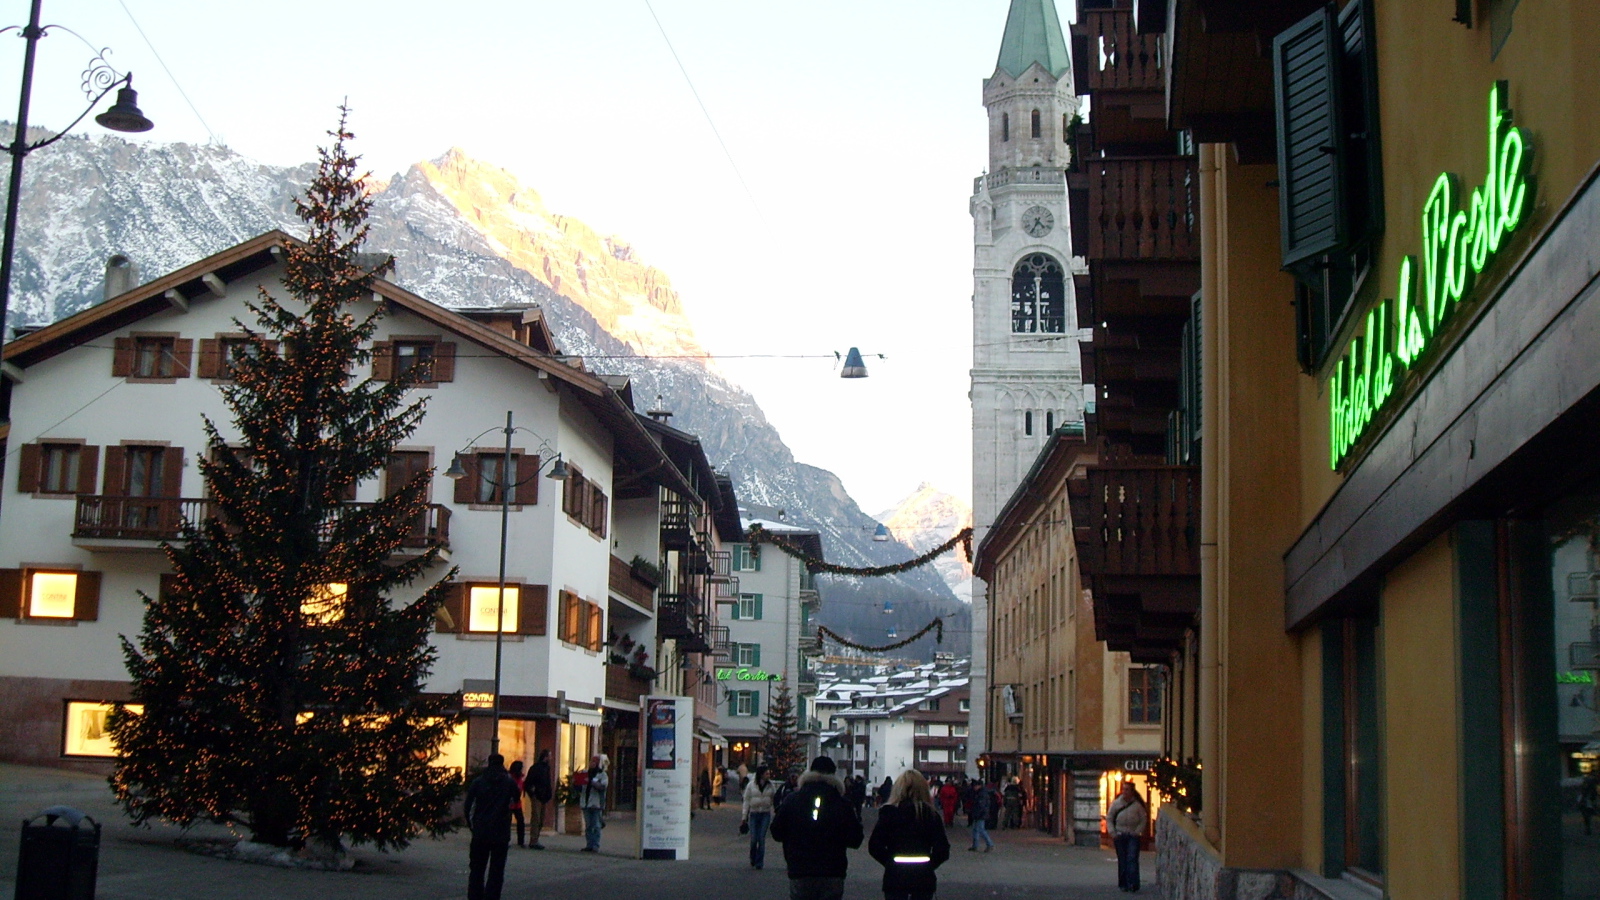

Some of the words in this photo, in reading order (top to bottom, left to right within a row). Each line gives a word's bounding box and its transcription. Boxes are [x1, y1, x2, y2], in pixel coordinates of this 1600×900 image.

[1330, 309, 1374, 471] Hotel
[1374, 301, 1393, 411] de
[1398, 256, 1425, 369] la
[1422, 82, 1526, 337] Poste
[463, 692, 495, 702] CONTINI
